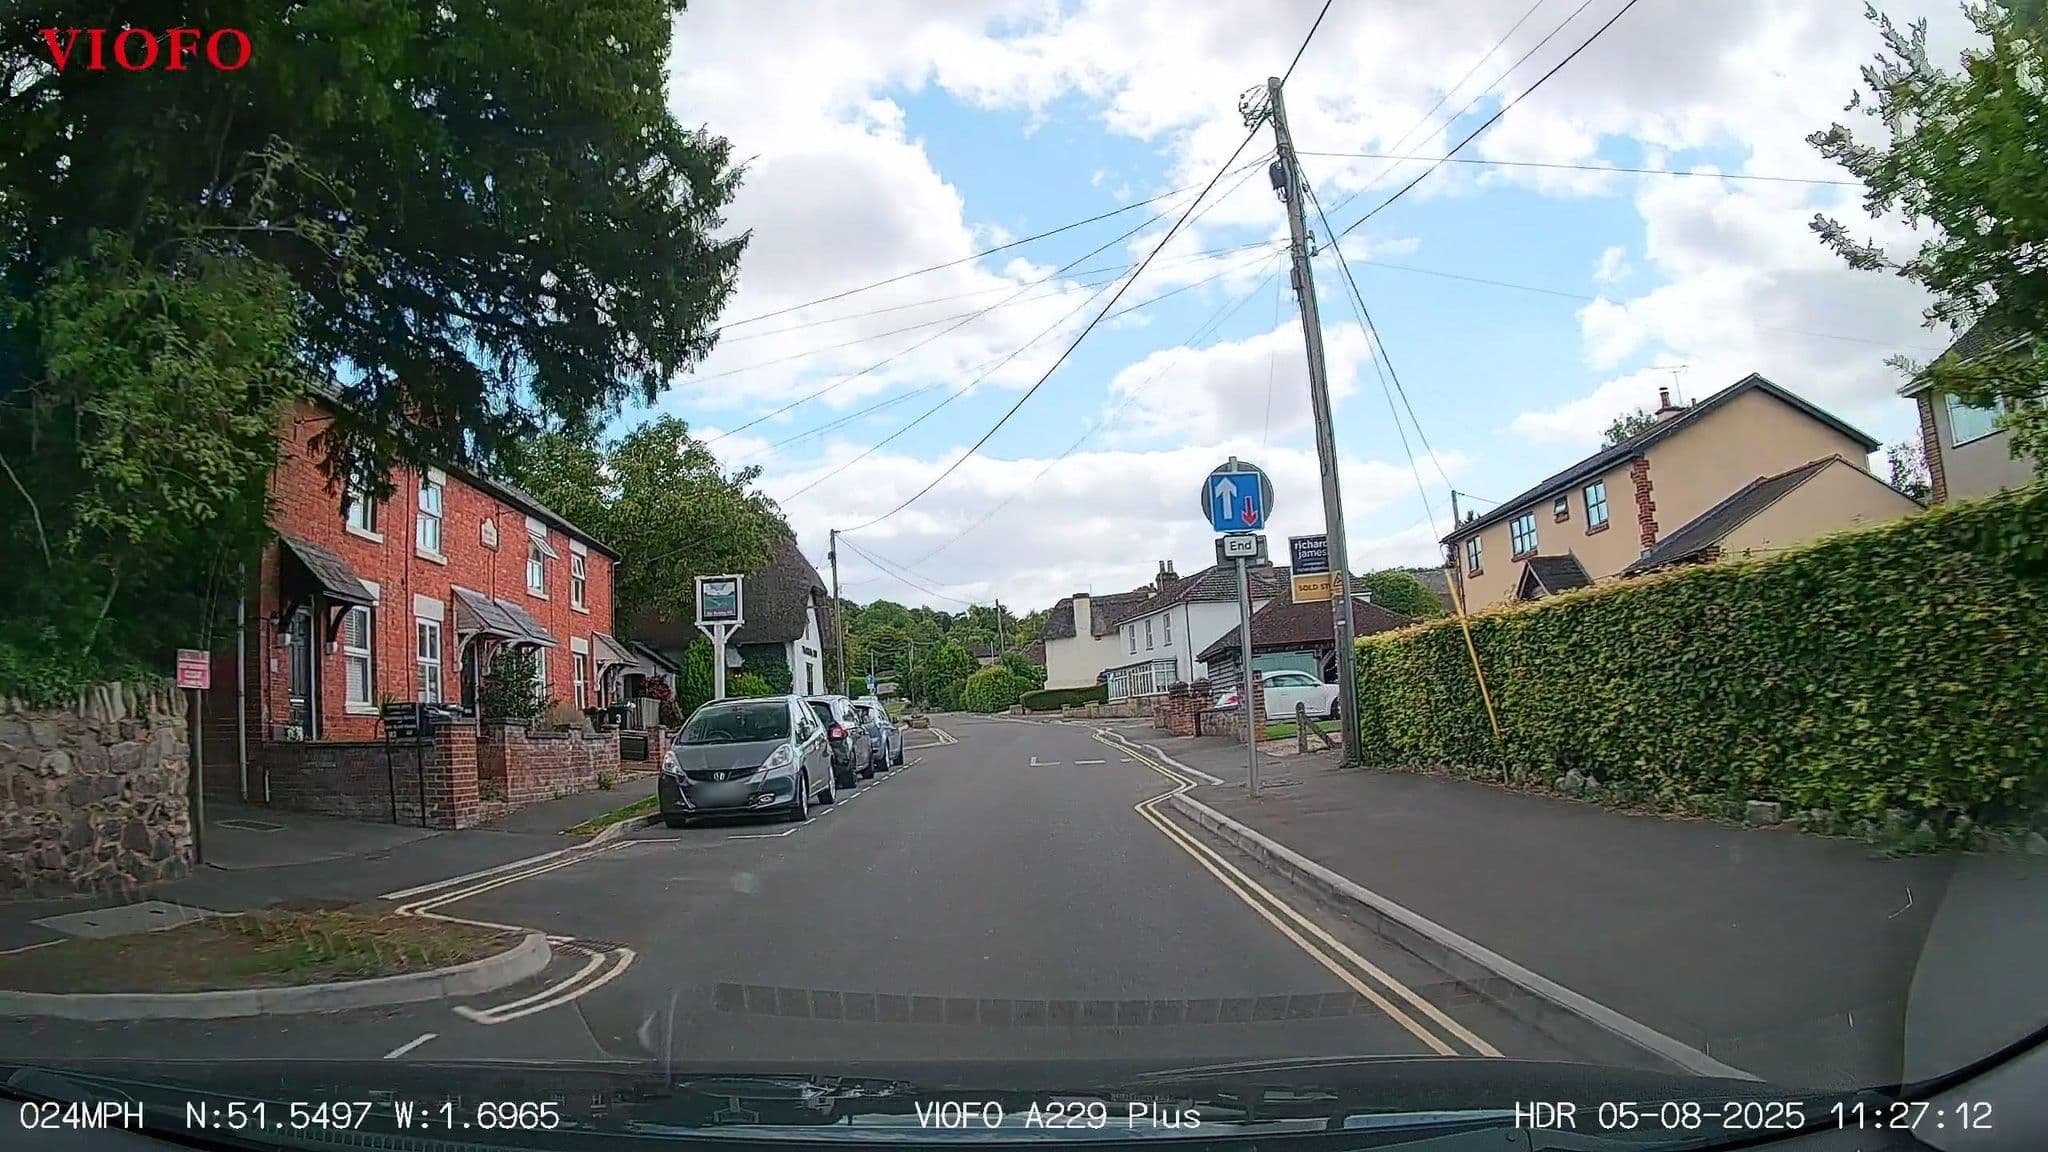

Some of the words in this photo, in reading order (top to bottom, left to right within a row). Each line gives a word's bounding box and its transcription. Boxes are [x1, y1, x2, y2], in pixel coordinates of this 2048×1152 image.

[1230, 540, 1252, 551] End
[1298, 549, 1327, 559] james
[615, 713, 622, 724] 3
